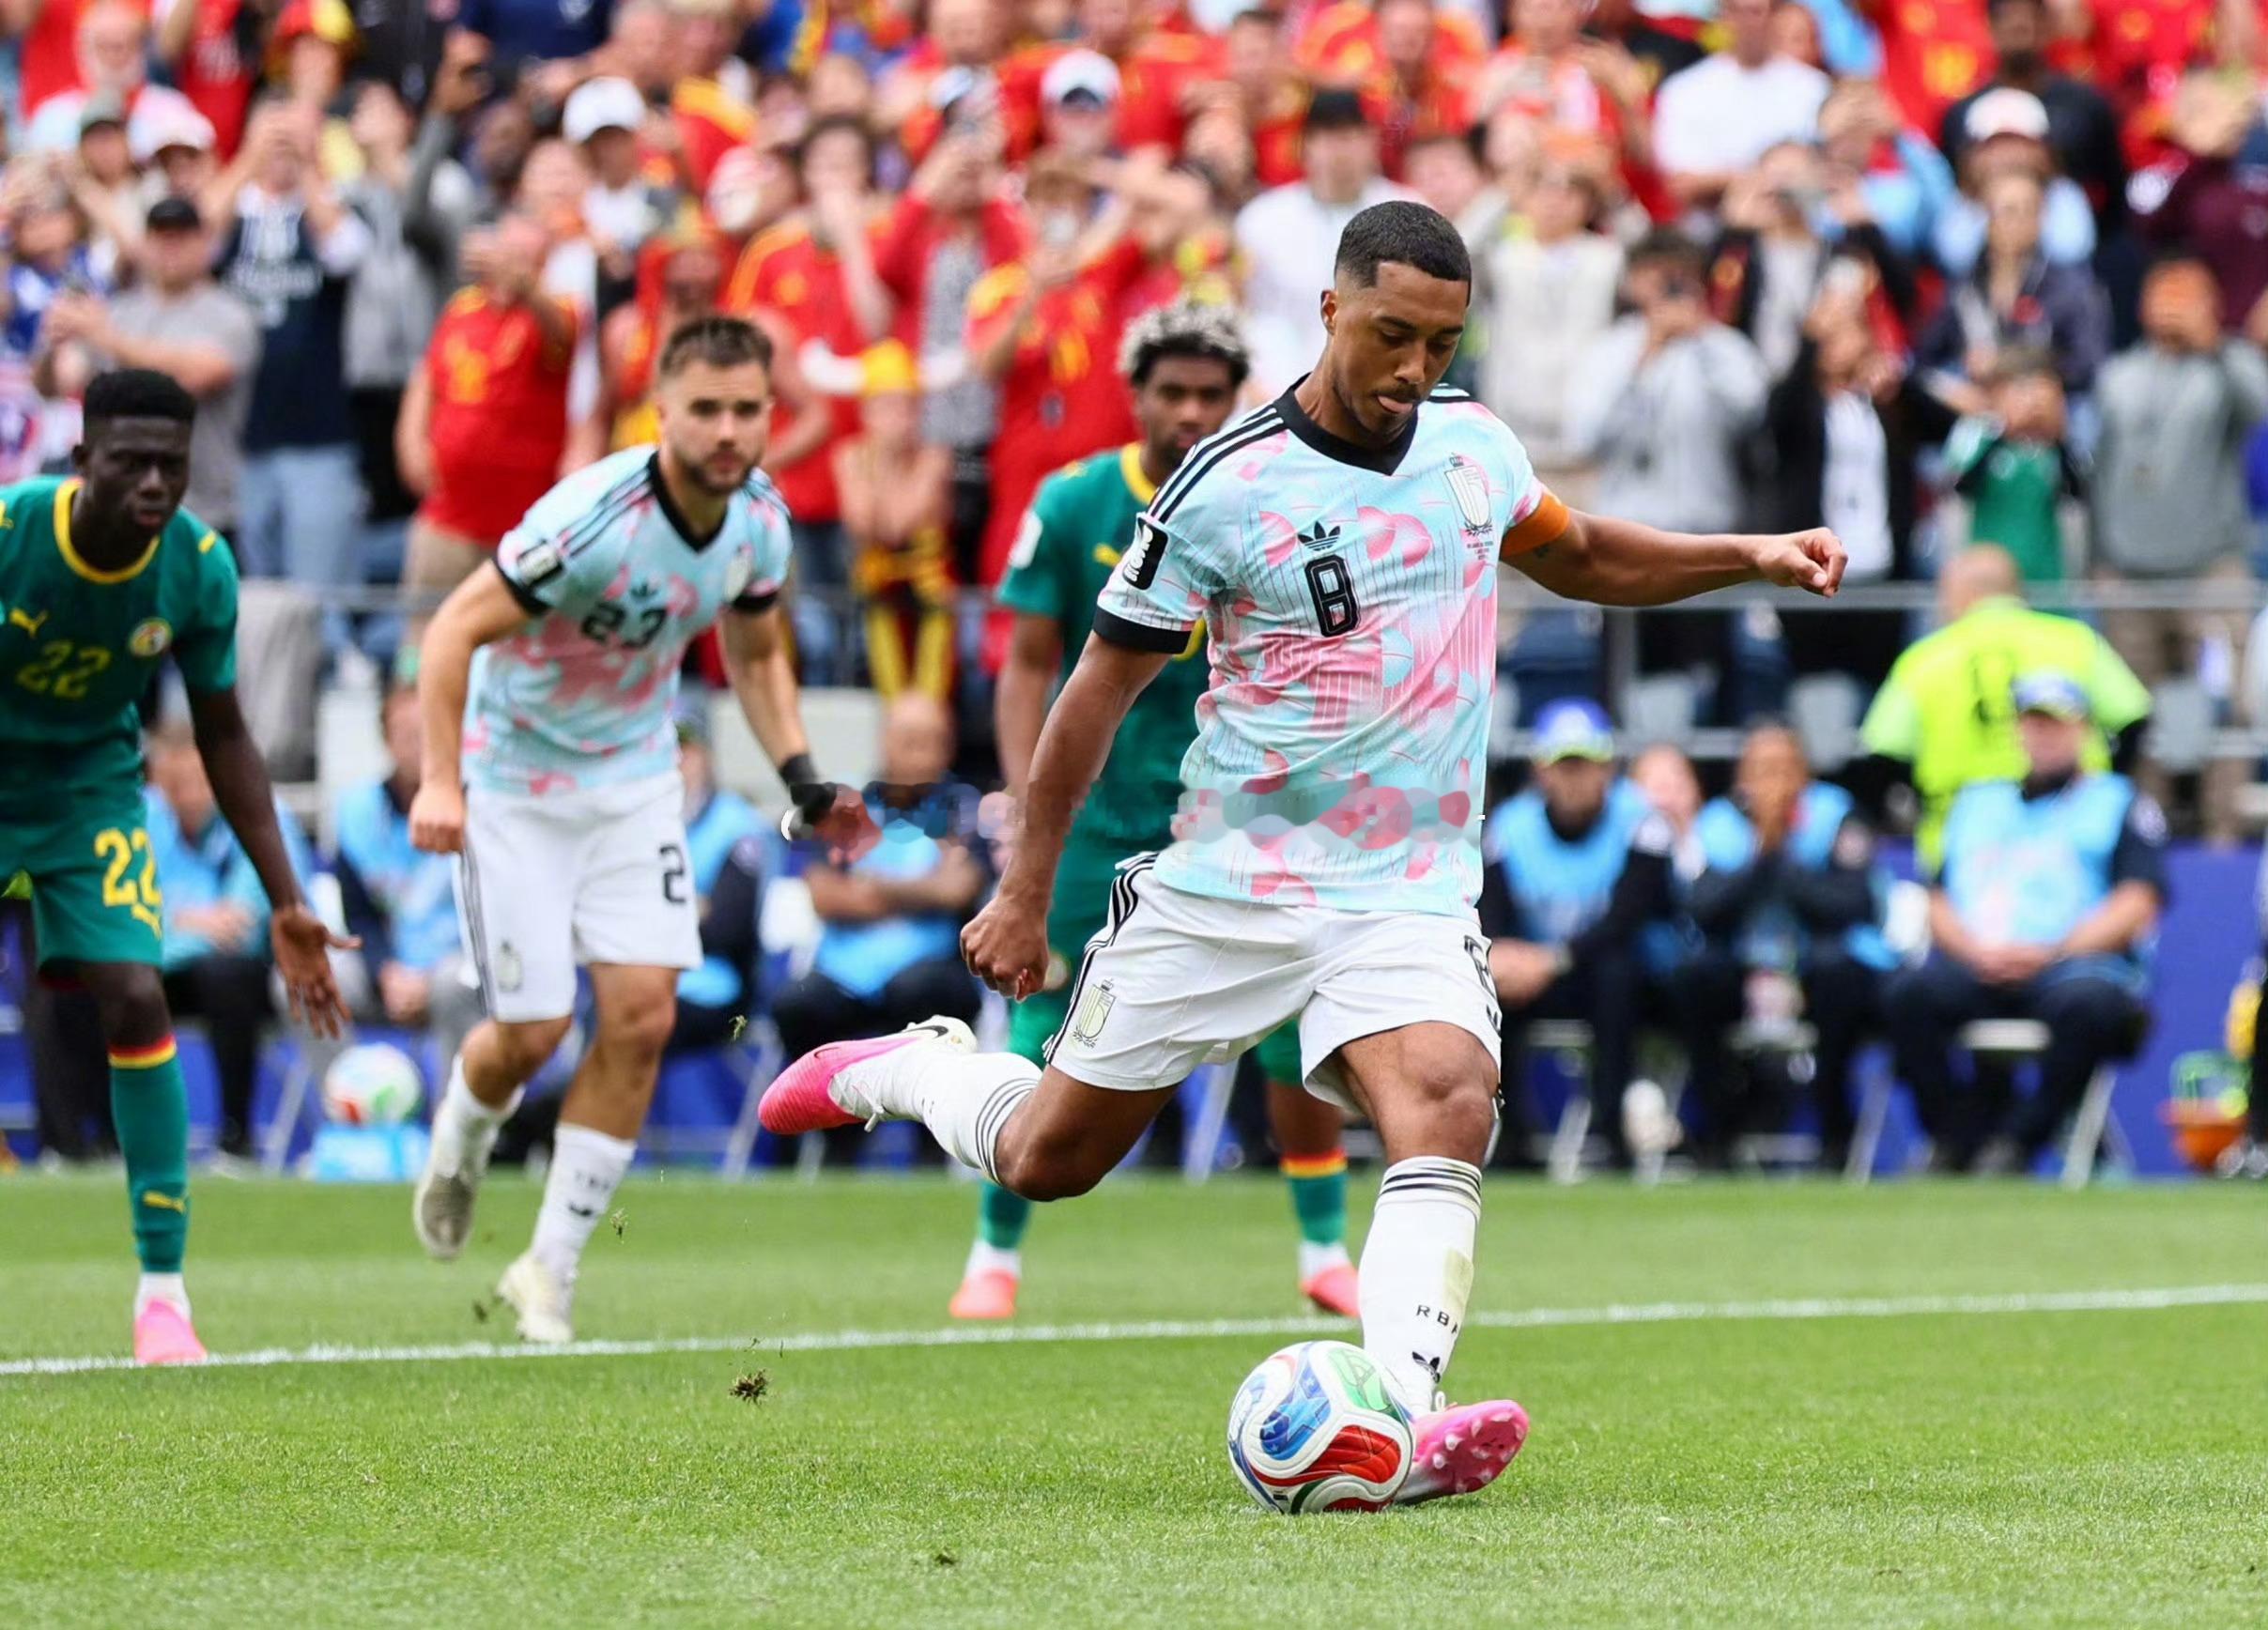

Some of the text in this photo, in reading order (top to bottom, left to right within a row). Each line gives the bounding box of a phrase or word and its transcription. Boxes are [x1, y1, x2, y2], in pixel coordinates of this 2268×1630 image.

[1304, 554, 1360, 638] 8
[17, 640, 112, 698] 22
[94, 827, 162, 907] 22
[659, 844, 687, 904] 2
